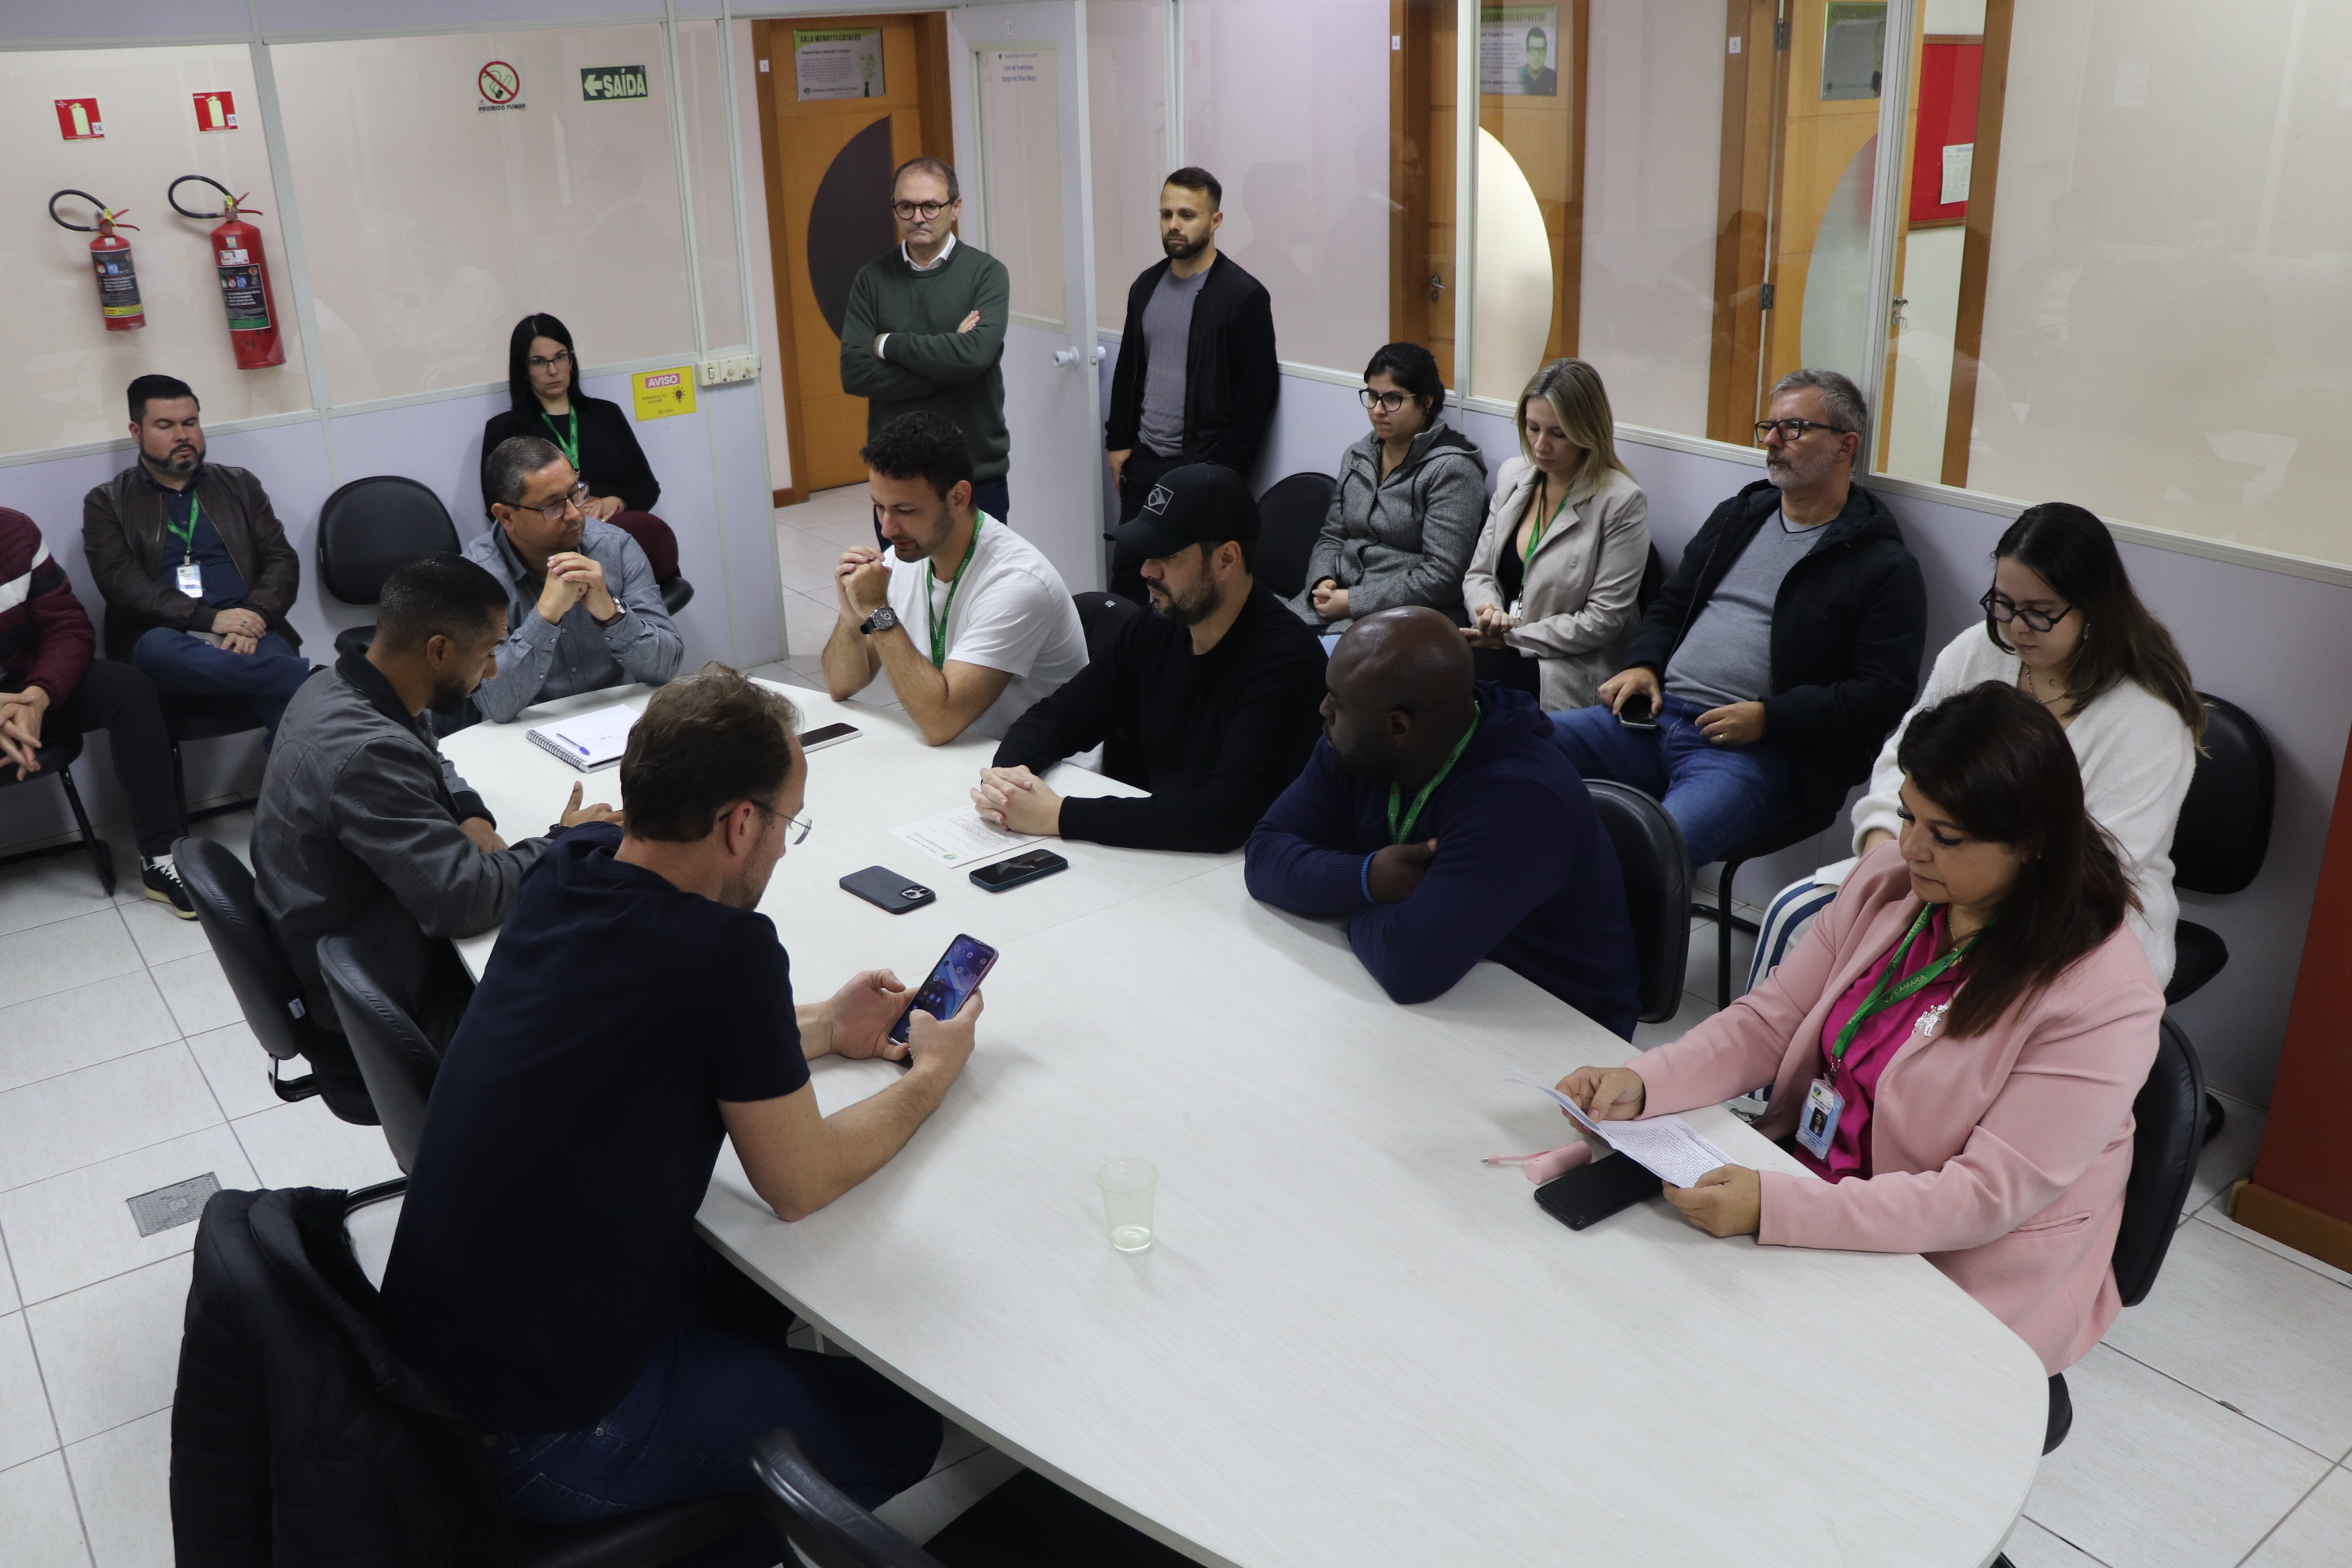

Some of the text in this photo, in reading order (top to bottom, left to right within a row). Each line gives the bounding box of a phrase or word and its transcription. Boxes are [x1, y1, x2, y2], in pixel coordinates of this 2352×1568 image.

[1732, 40, 1737, 51] 5
[602, 68, 647, 98] SAÍDA
[647, 375, 679, 388] AVISO
